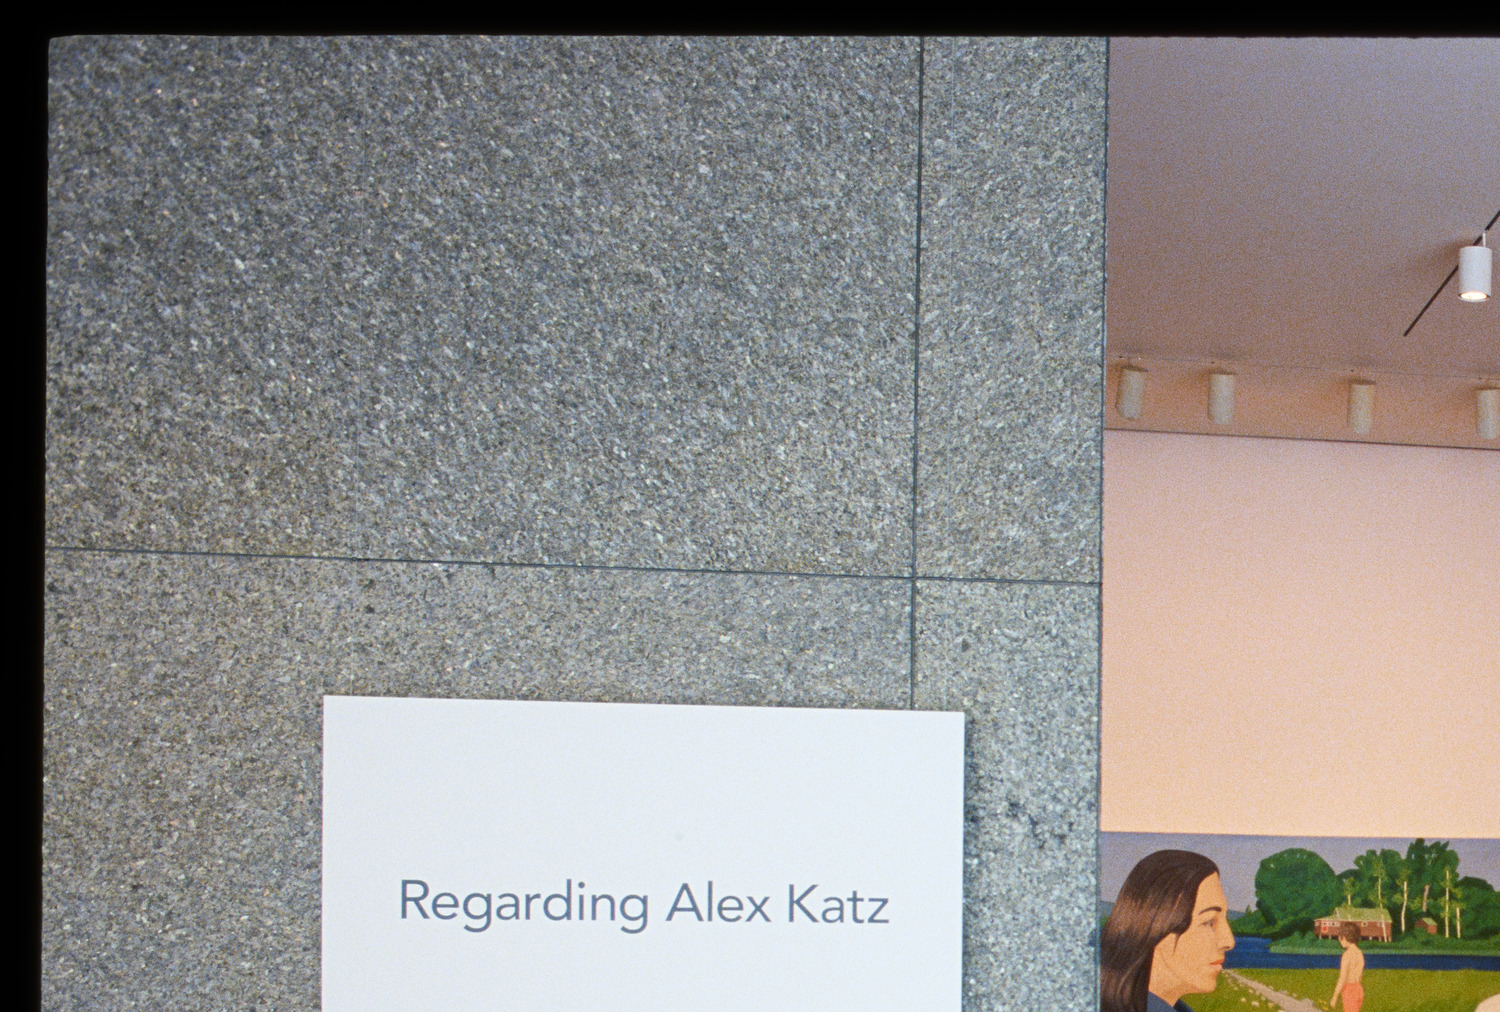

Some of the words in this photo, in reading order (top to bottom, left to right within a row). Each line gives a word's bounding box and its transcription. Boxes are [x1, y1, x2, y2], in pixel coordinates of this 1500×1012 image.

[400, 878, 649, 935] Regarding
[665, 880, 772, 923] Alex
[788, 883, 890, 924] Katz
